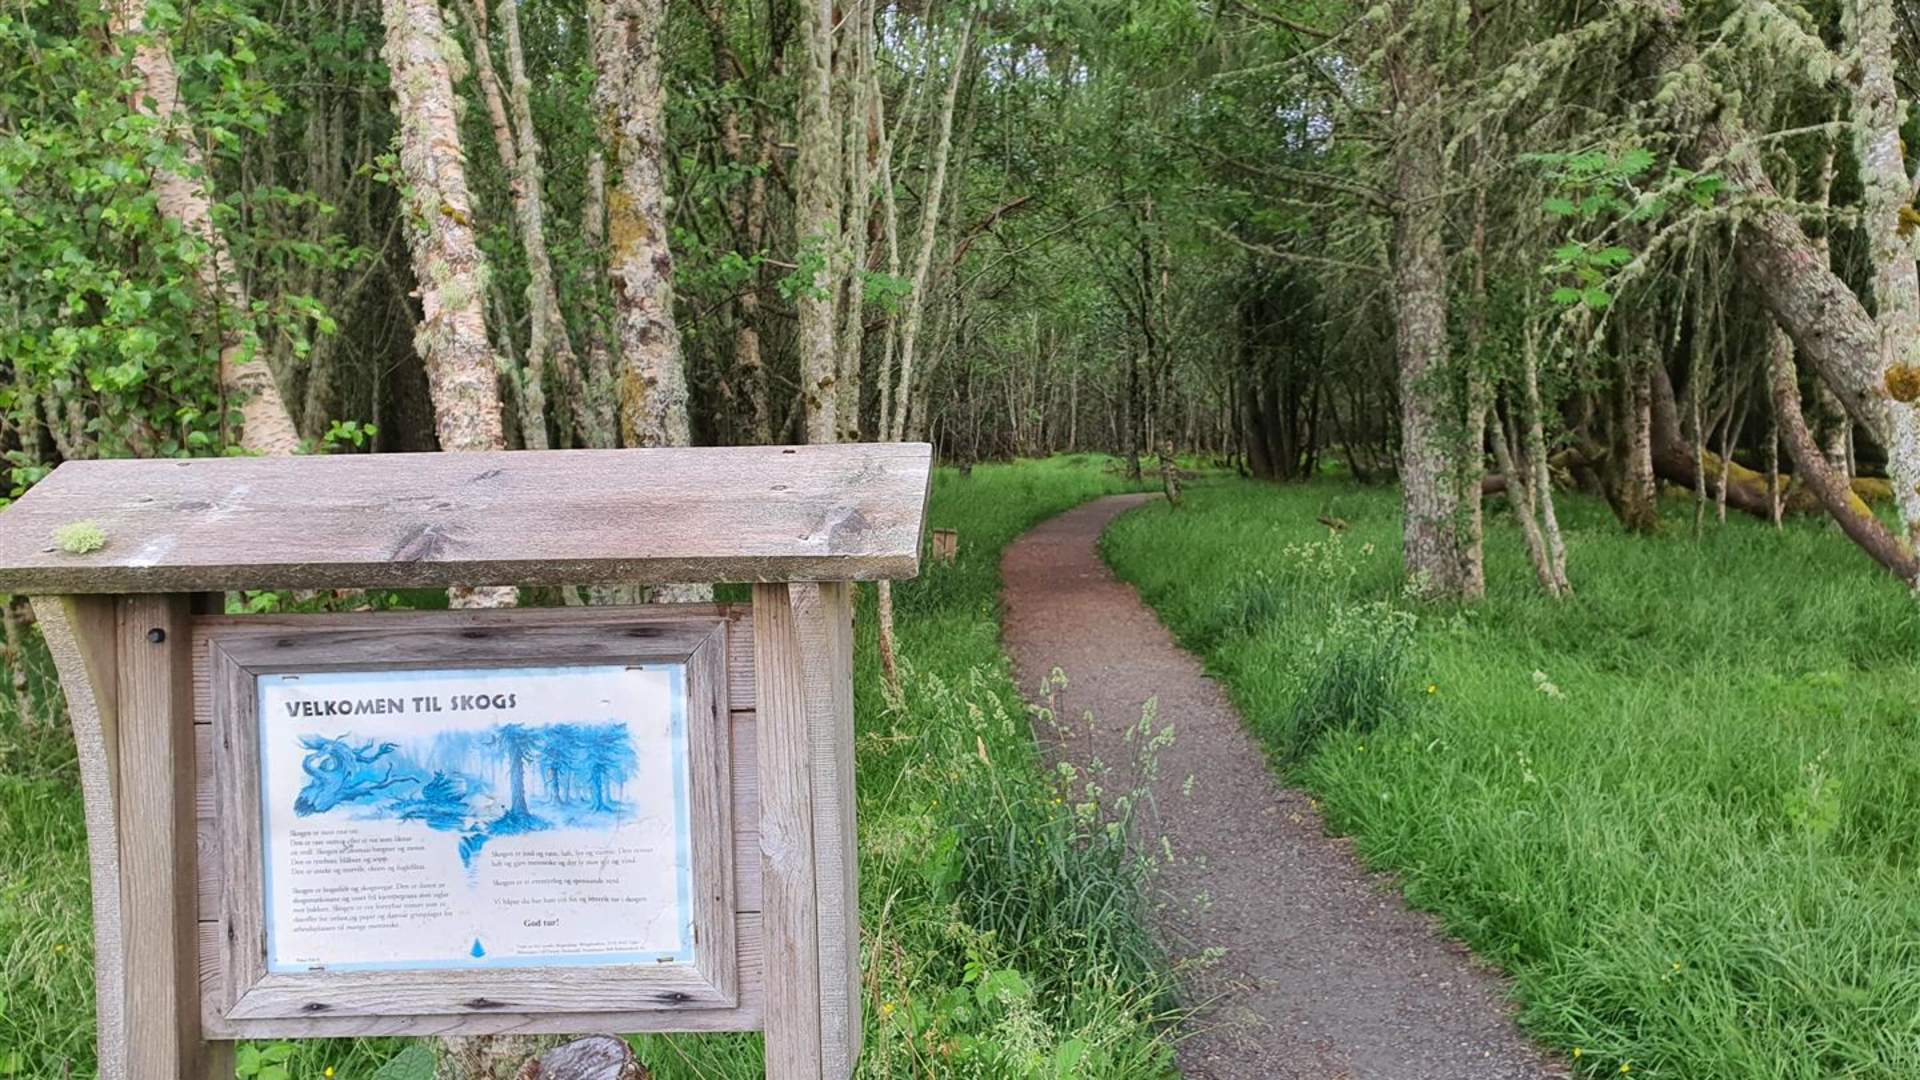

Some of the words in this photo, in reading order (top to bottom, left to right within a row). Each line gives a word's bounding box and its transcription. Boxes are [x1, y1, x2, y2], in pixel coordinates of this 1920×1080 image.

[285, 698, 405, 717] VELKOMEN
[412, 696, 443, 713] TIL
[450, 693, 517, 711] SKOGS
[523, 919, 541, 927] God
[543, 918, 560, 927] tur!
